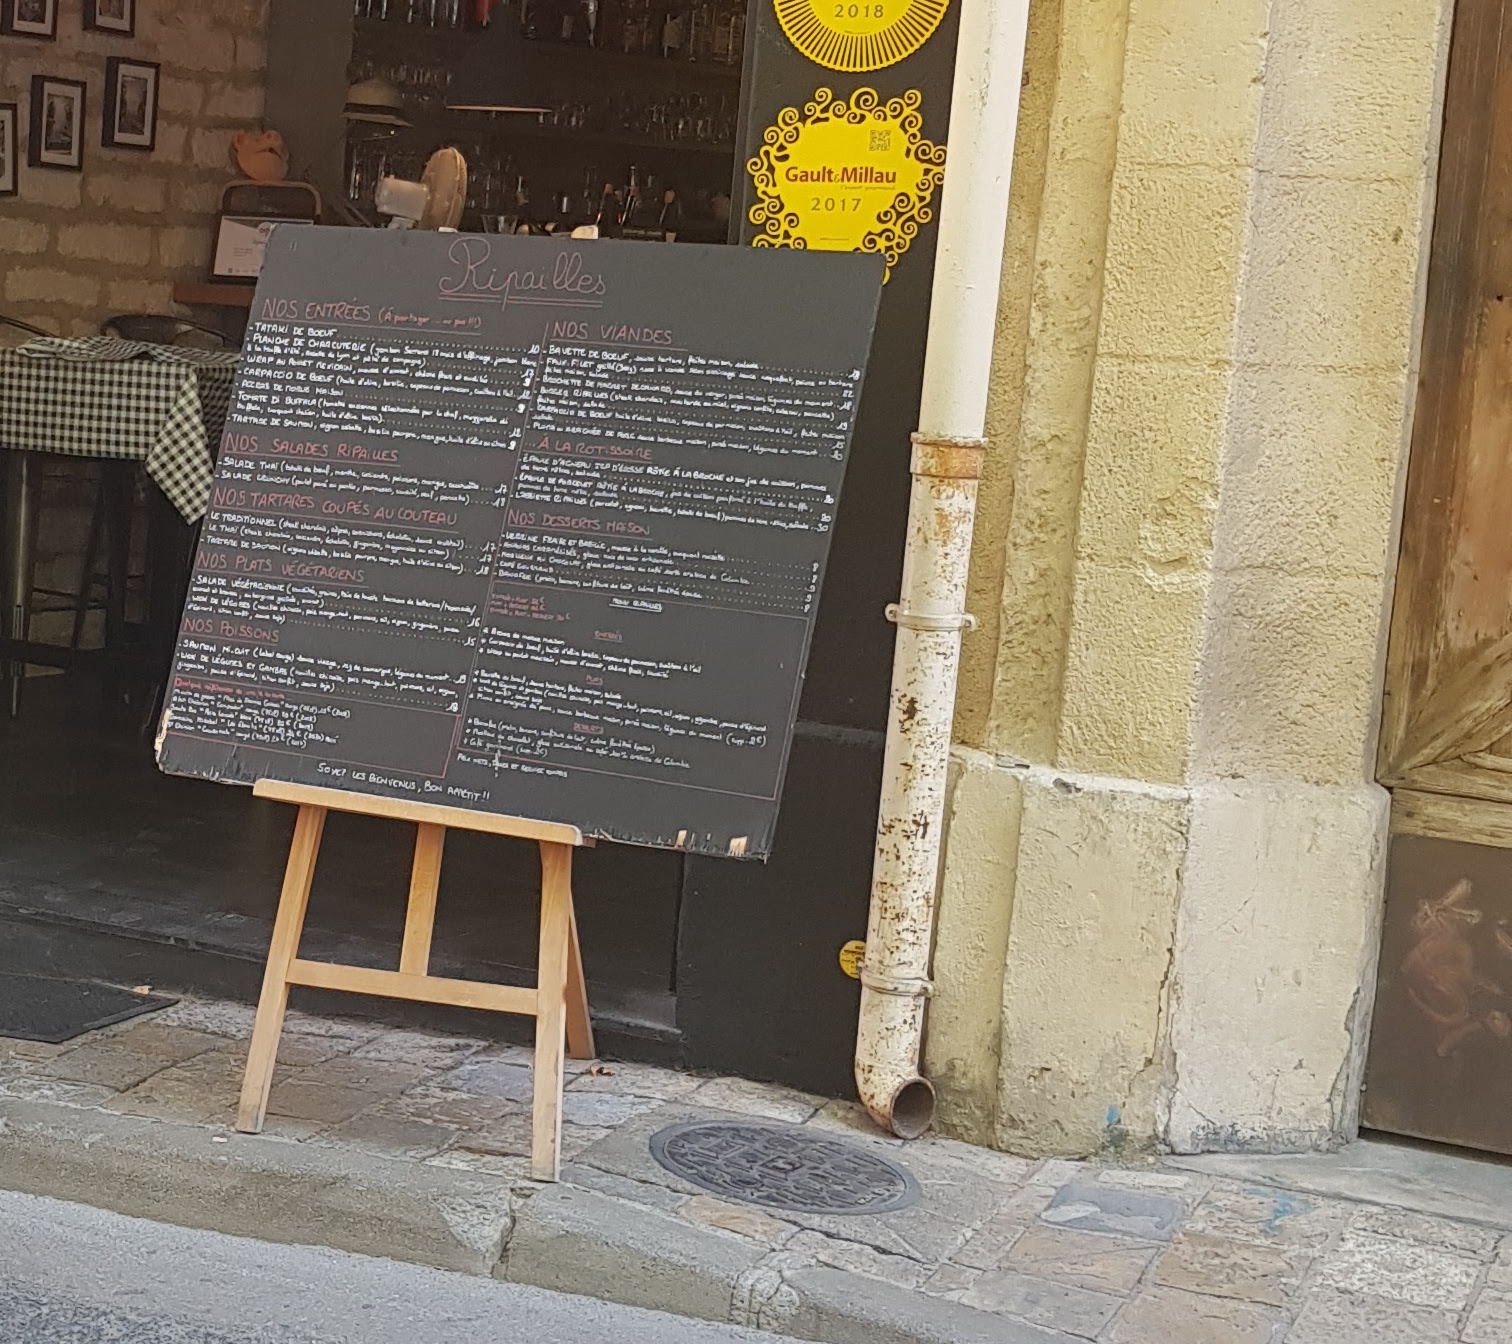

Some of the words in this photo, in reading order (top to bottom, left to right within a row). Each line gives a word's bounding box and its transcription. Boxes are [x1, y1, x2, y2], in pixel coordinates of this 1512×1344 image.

[835, 4, 884, 18] 2018
[785, 166, 897, 183] Gault&Millau
[811, 198, 861, 212] 2017
[439, 236, 605, 308] Ripailles
[261, 297, 297, 319] NOS
[254, 321, 288, 333] TATAKI
[292, 326, 304, 336] DE
[552, 320, 588, 339] NOS
[600, 324, 672, 344] VIANDES
[292, 337, 305, 346] DE
[246, 354, 274, 364] WRAP
[243, 367, 293, 379] CARPACCIO
[295, 372, 306, 380] DE
[224, 432, 258, 454] NOS
[270, 438, 328, 457] SALADES
[554, 440, 571, 452] LA
[212, 486, 245, 506] NOS
[250, 492, 314, 508] TARTARES
[321, 499, 369, 515] COUPÉS
[373, 506, 394, 519] AU
[397, 507, 457, 525] COUTEAU
[507, 508, 535, 525] NOS
[197, 551, 227, 569] NOS
[235, 554, 272, 571] PLATS
[184, 617, 213, 633] NOS
[219, 620, 279, 642] POISSONS
[351, 770, 366, 780] LES
[423, 780, 442, 792] BON
